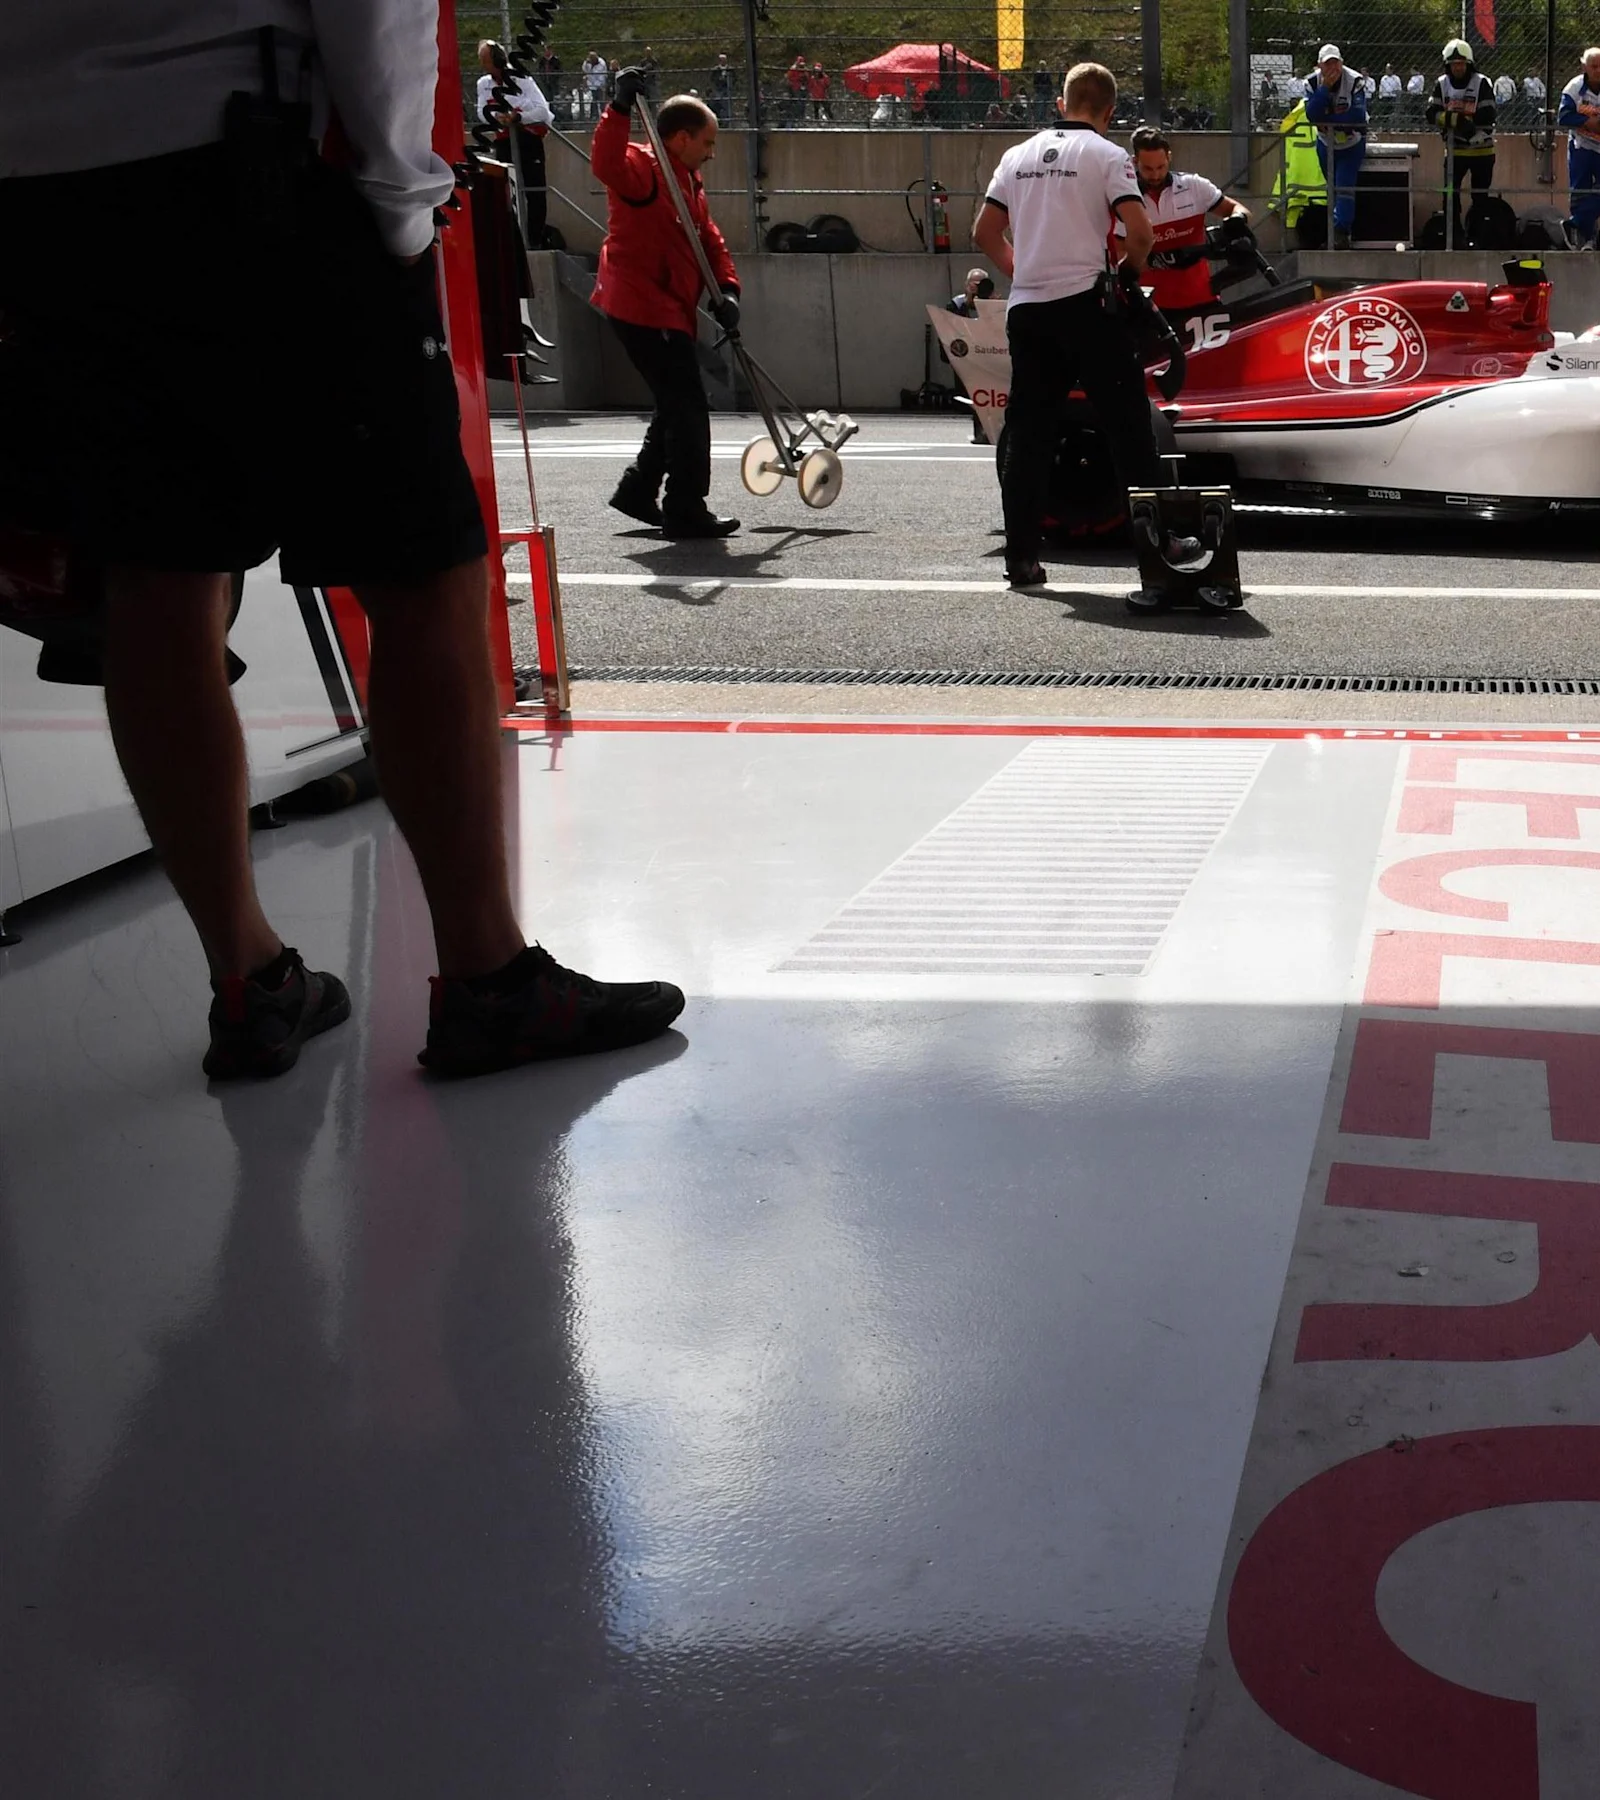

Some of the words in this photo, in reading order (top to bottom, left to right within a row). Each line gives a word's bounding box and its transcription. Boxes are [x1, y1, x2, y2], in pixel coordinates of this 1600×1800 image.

[1184, 313, 1230, 353] 16
[1311, 308, 1348, 355] ALFA
[1358, 301, 1421, 356] ROMEO
[974, 345, 1008, 355] Sauber
[1344, 730, 1458, 739] PIT
